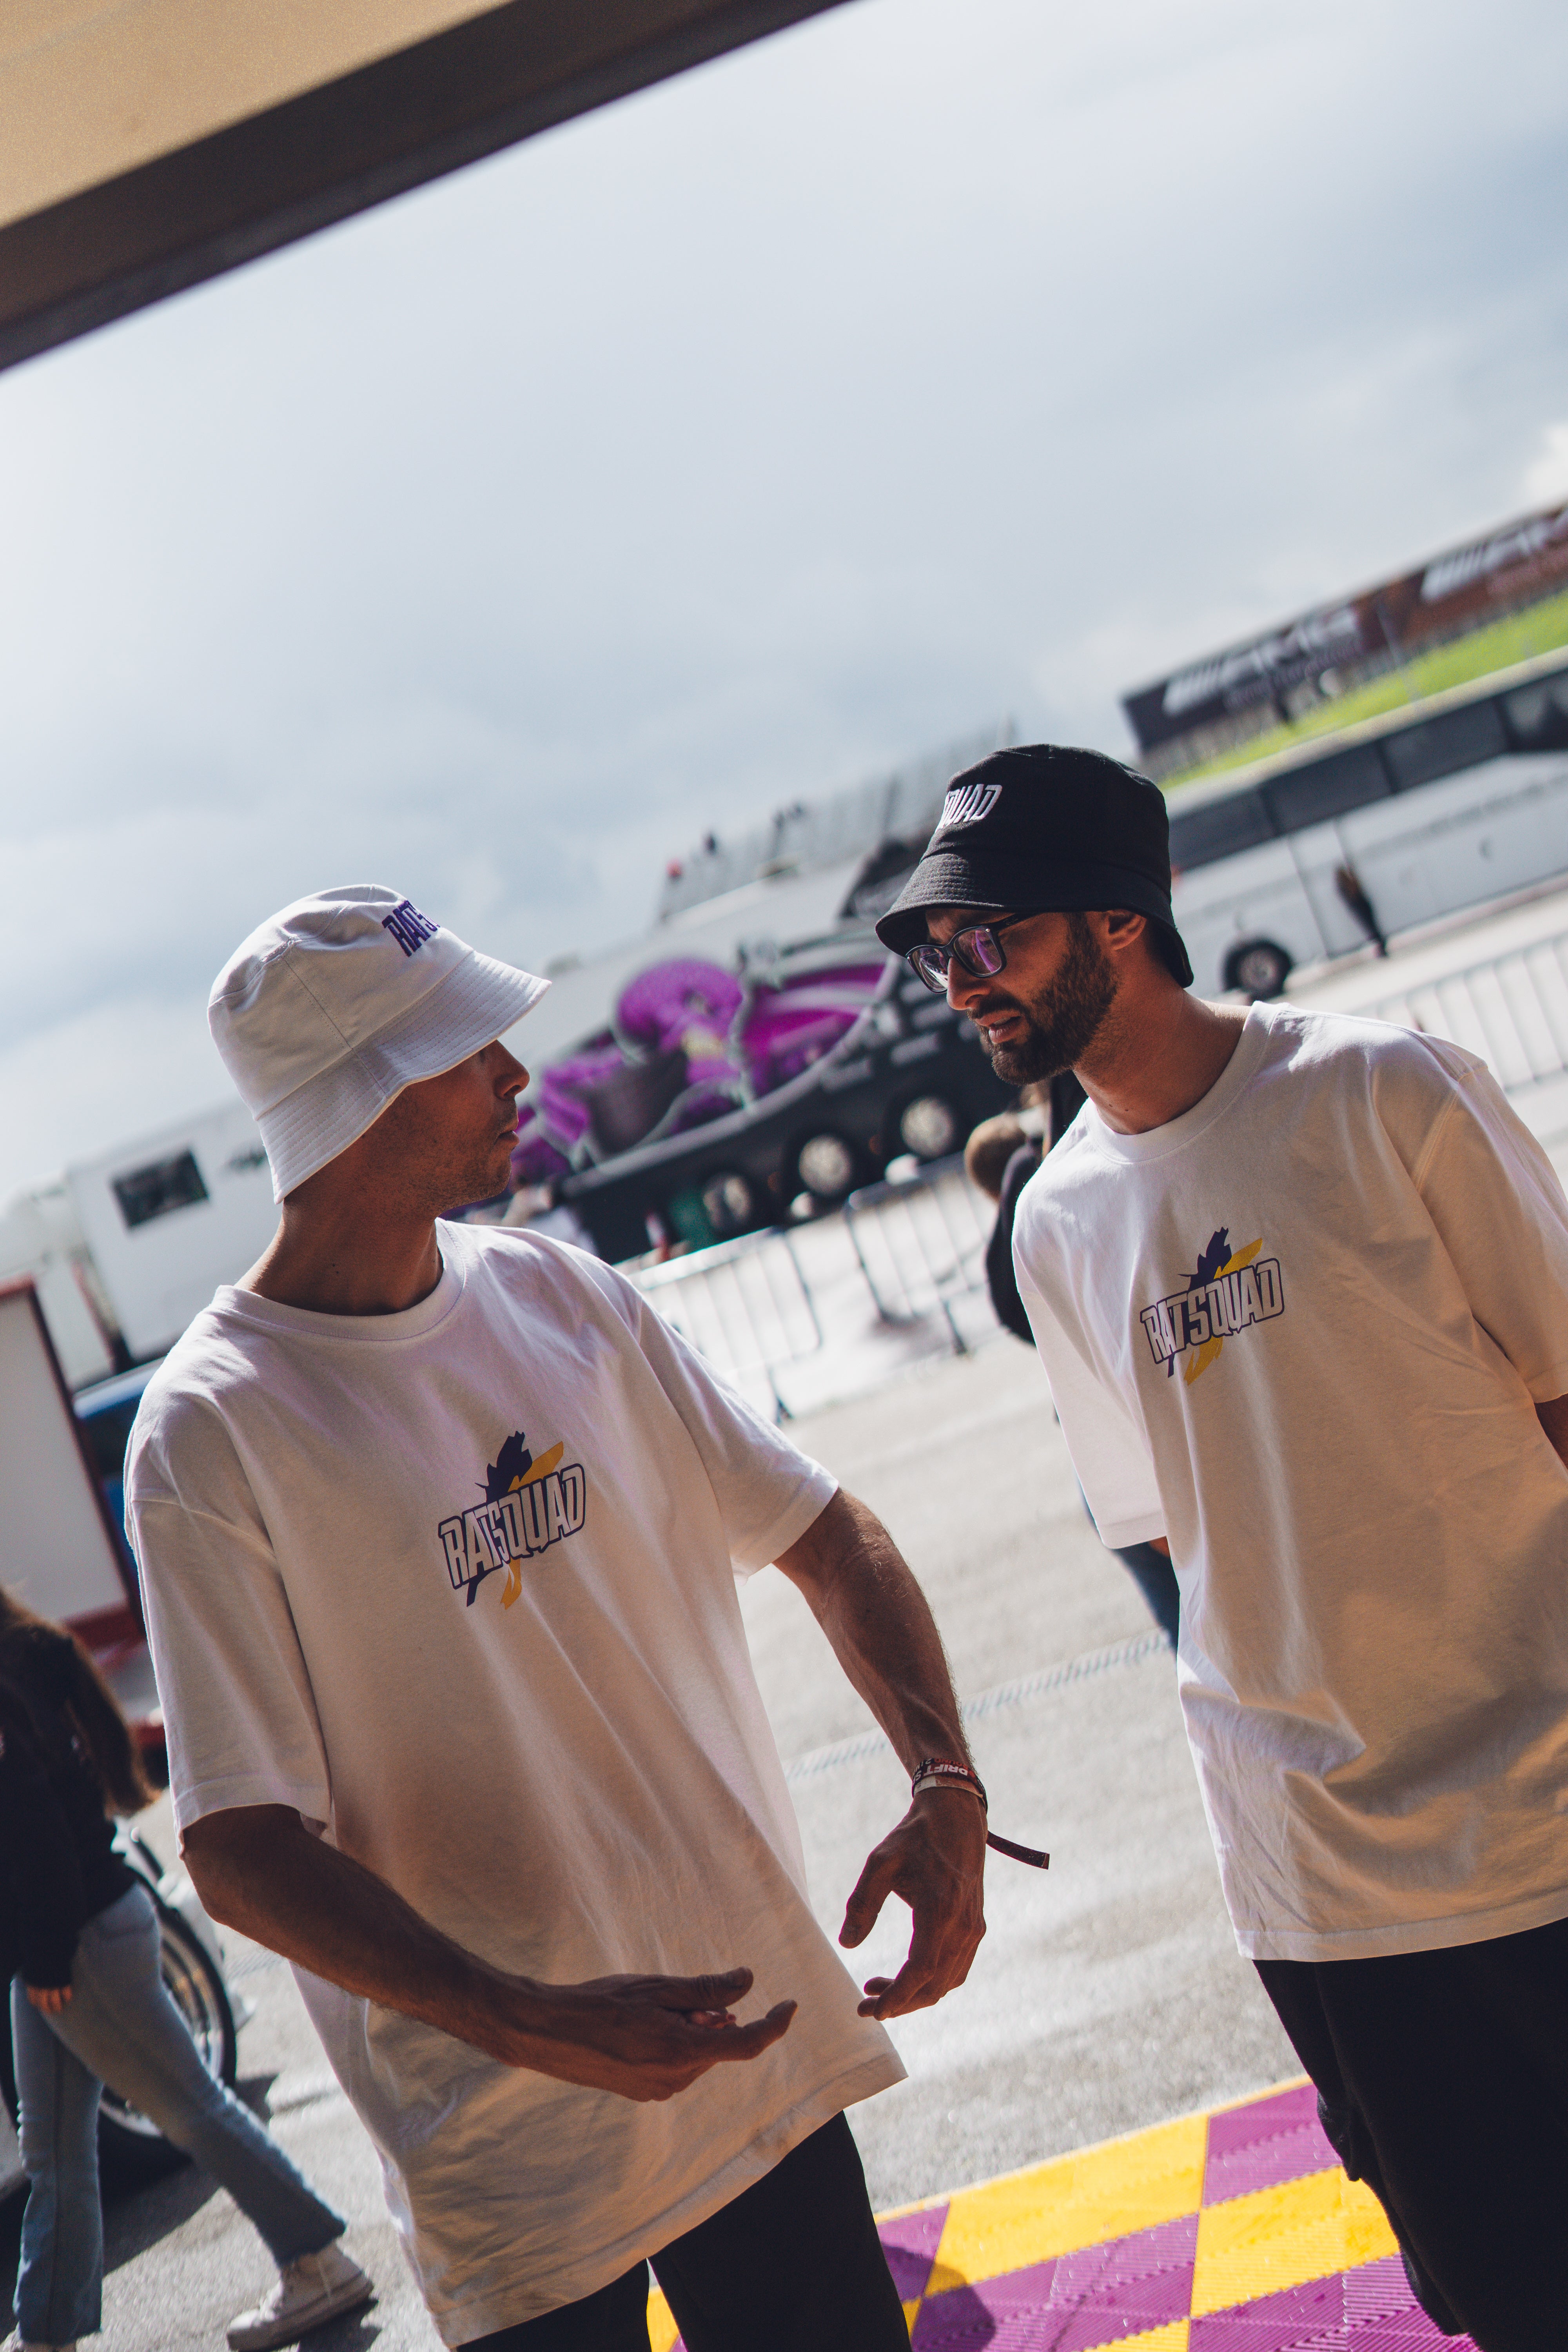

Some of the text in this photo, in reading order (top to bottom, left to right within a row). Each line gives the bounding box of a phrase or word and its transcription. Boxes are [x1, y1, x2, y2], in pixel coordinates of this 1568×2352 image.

[382, 900, 440, 957] RATS
[1140, 1258, 1285, 1364] RATSQUAD
[438, 1463, 586, 1590] RATSQUAD
[924, 1764, 968, 1776] DRIFT
